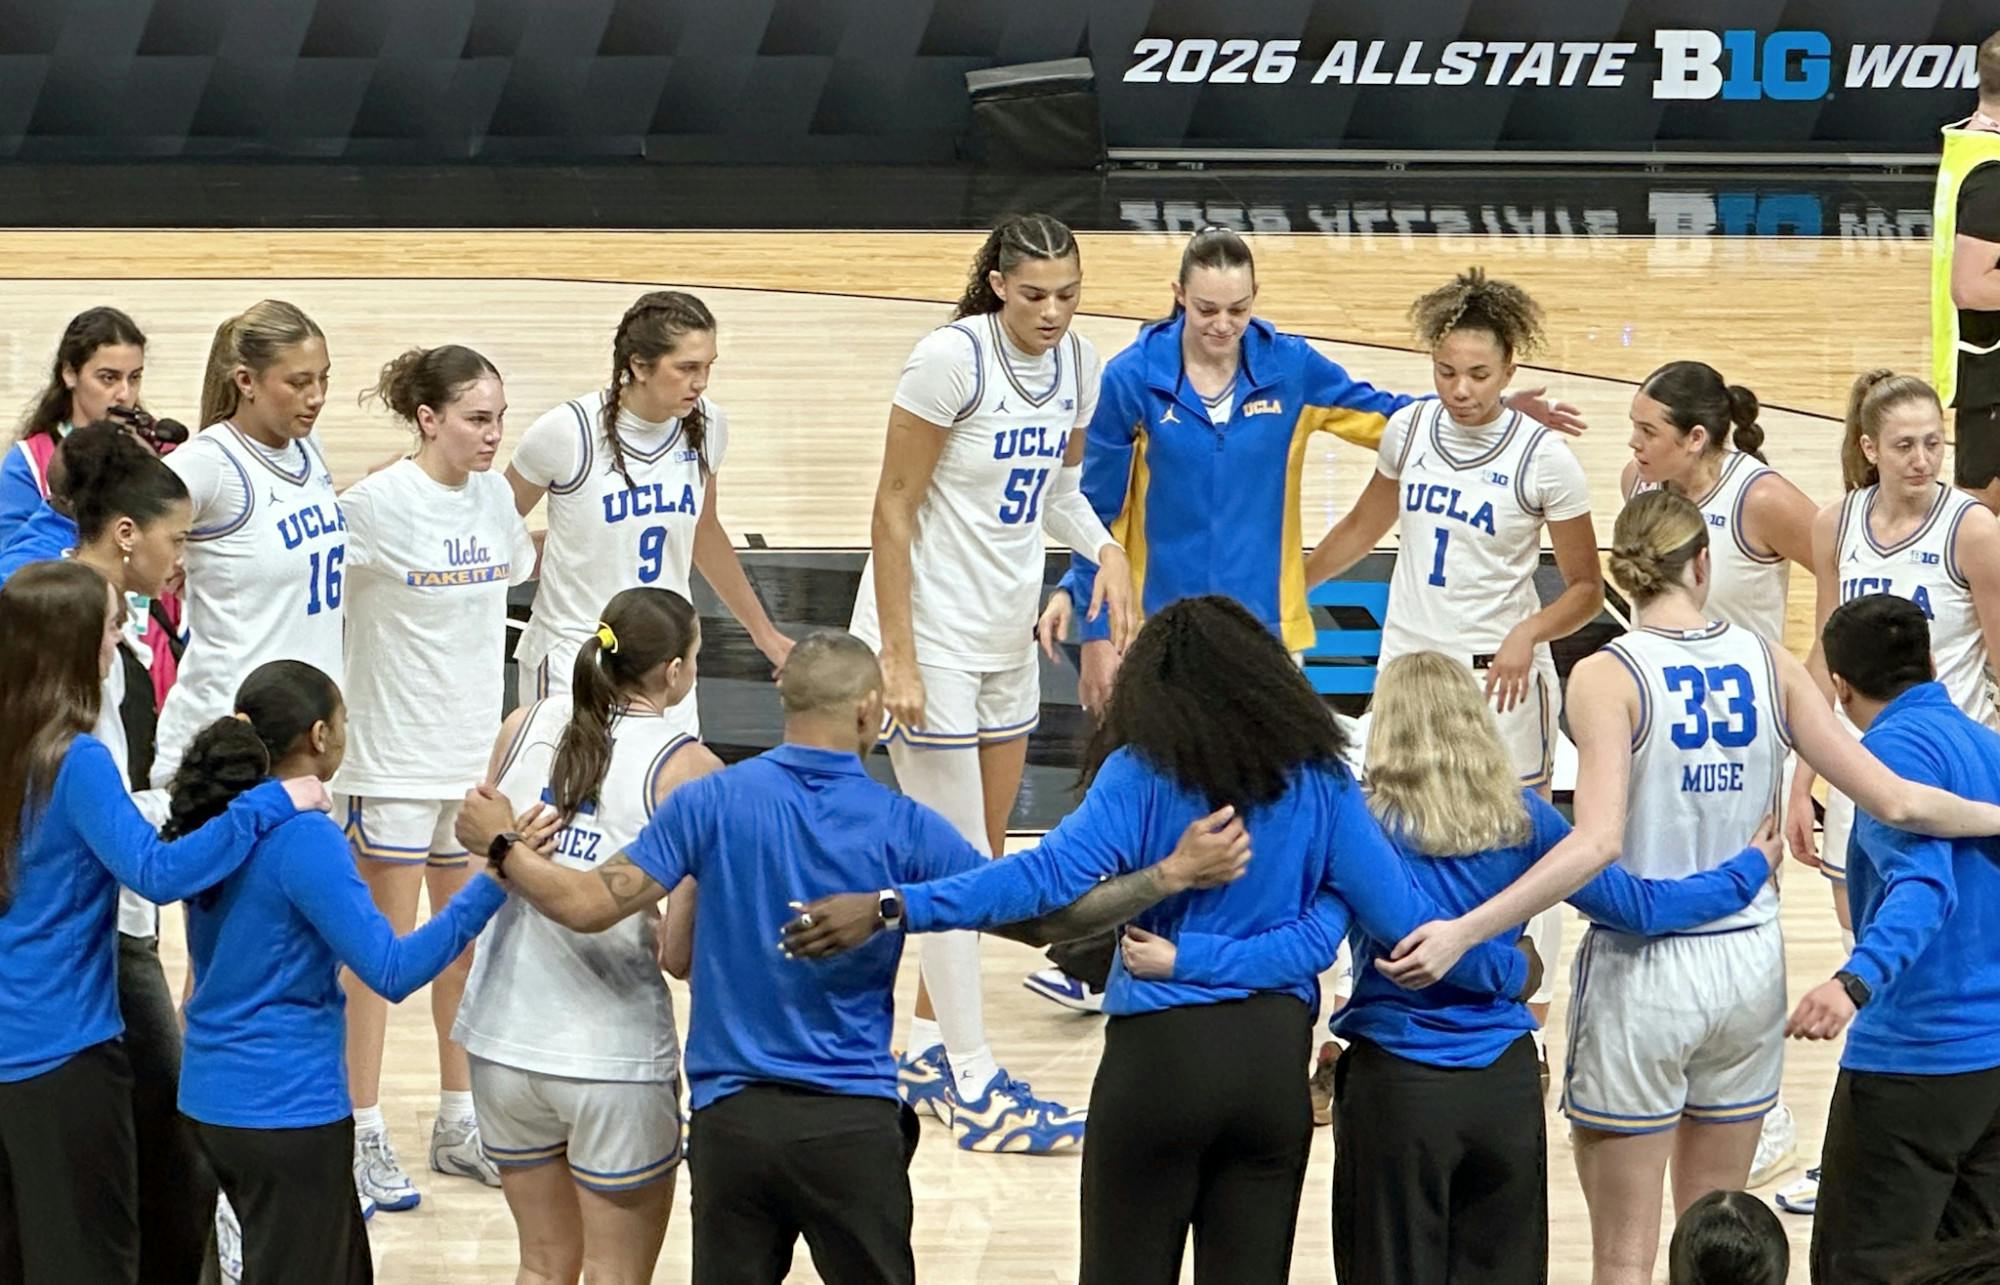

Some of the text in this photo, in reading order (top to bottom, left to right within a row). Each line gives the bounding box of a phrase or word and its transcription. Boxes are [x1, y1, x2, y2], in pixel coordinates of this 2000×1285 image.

[1122, 38, 1301, 84] 2026
[1310, 40, 1637, 87] ALLSTATE
[1242, 399, 1282, 418] UCLA
[602, 483, 697, 524] UCLA
[999, 468, 1050, 524] 51
[1406, 483, 1496, 536] UCLA
[1706, 513, 1727, 529] 1G
[443, 535, 491, 566] Ucla
[638, 525, 668, 584] 9
[1428, 526, 1449, 588] 1
[307, 543, 345, 615] 16
[408, 569, 469, 586] TAKE
[472, 567, 488, 582] IT
[1662, 663, 1758, 750] 33
[1681, 762, 1744, 793] MUSE
